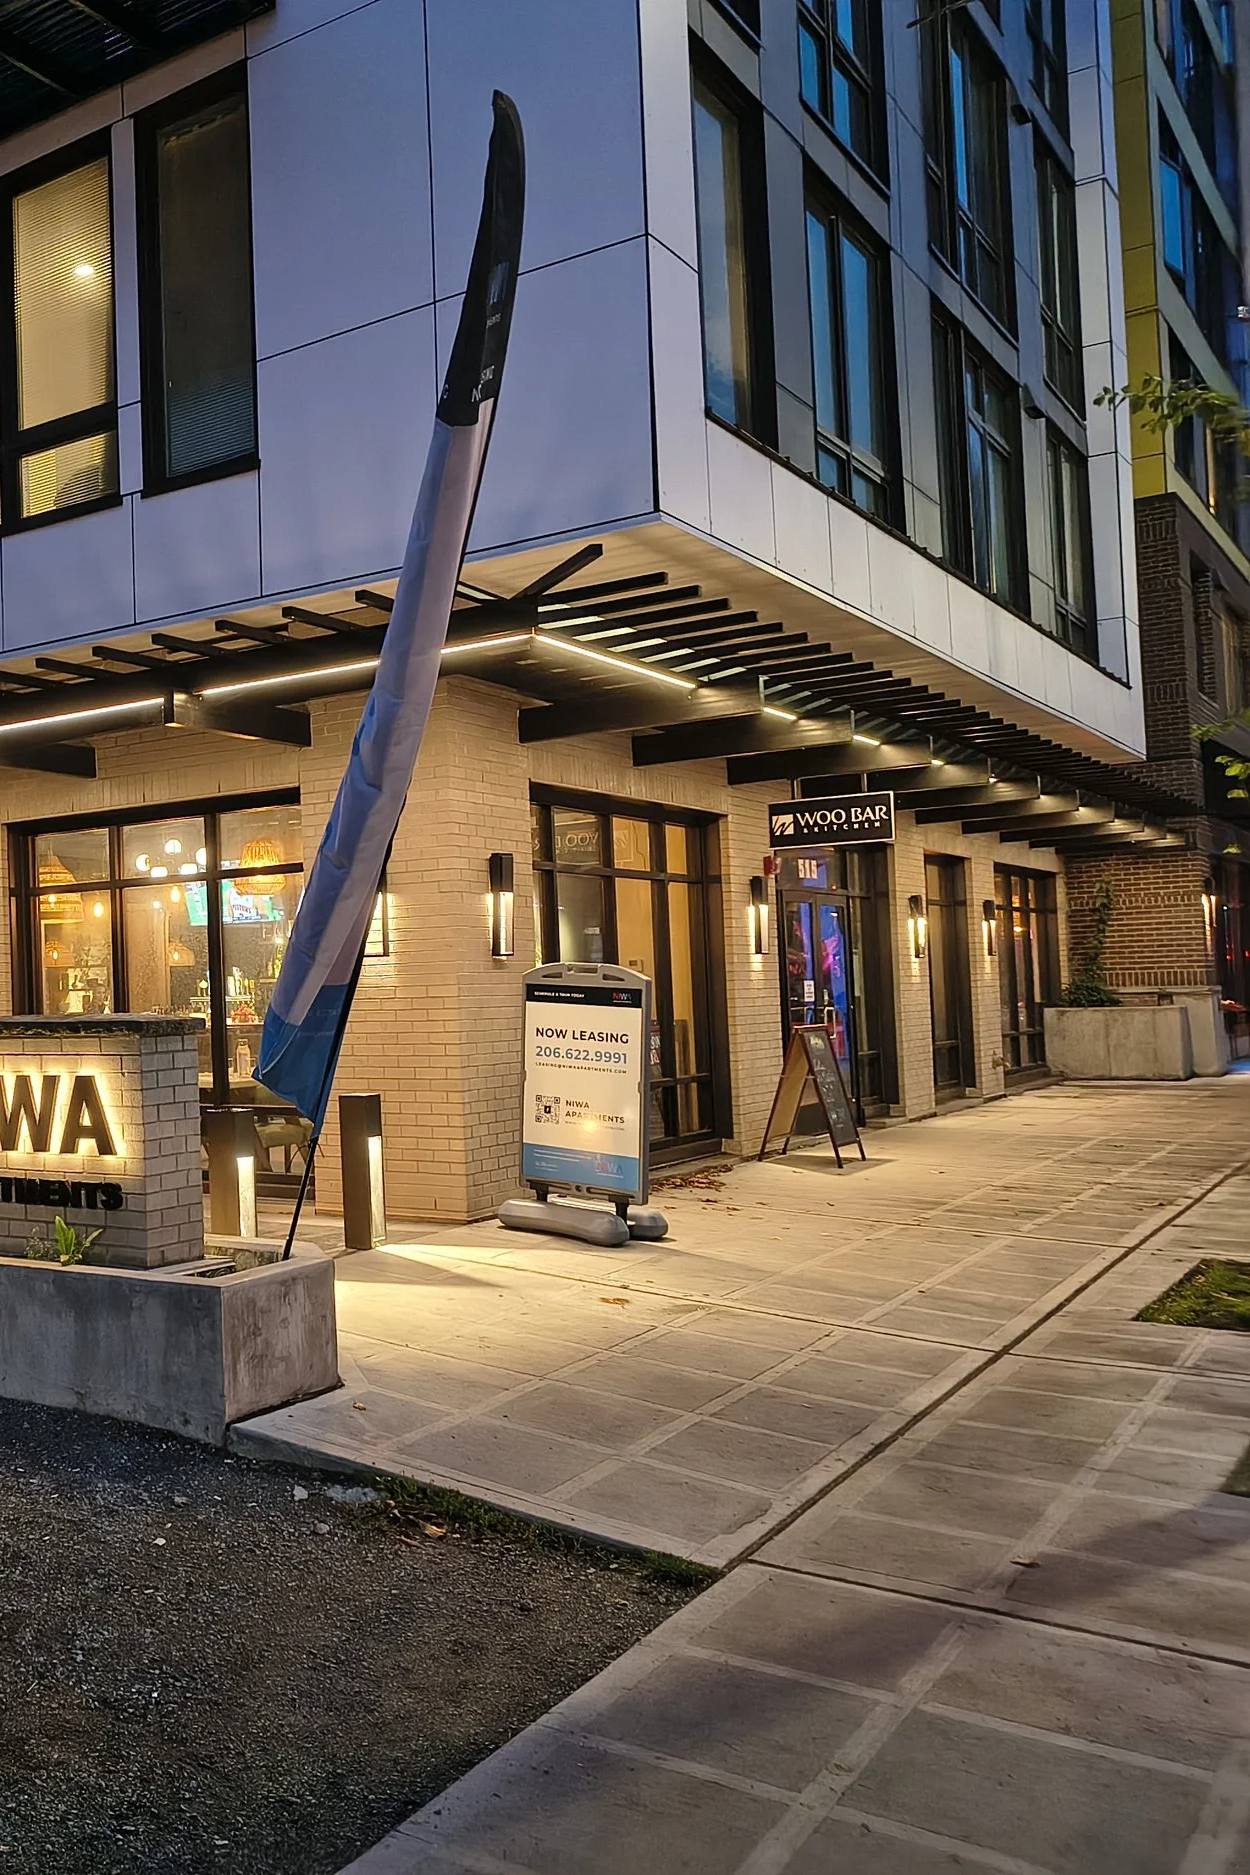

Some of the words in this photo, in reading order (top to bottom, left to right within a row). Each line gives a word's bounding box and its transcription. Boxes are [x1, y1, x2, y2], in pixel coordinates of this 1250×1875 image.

[796, 809, 846, 827] WOO
[850, 805, 890, 823] BAR
[535, 1027, 568, 1040] NOW
[572, 1029, 630, 1045] LEASING
[535, 1045, 627, 1065] 206.622.9991
[565, 1099, 590, 1109] NIWA
